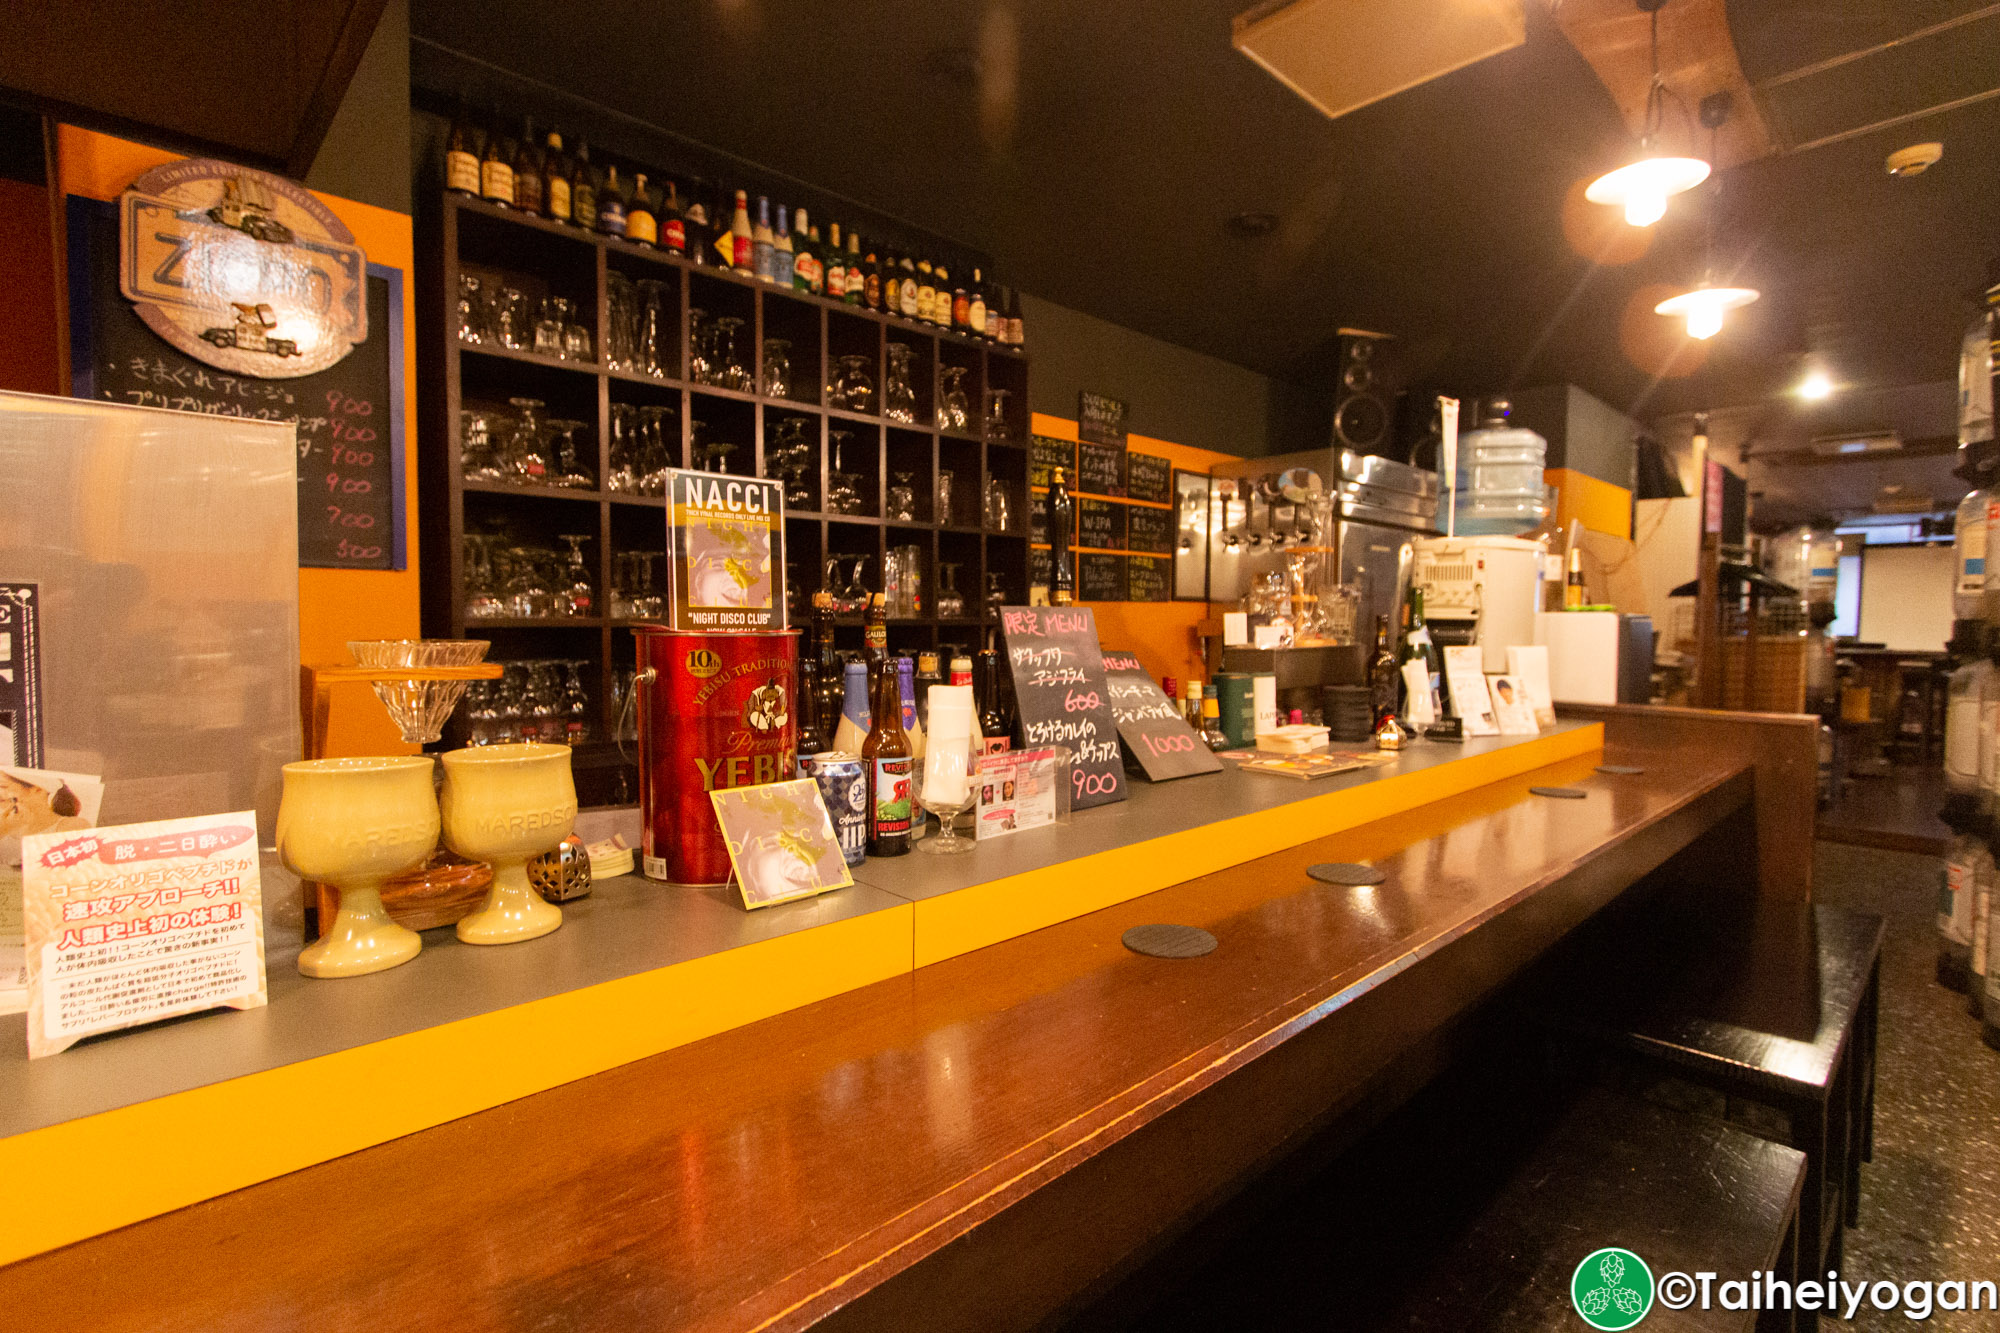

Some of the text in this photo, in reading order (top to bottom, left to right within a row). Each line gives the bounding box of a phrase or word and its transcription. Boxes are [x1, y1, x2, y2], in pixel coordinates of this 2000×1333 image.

[160, 165, 207, 184] LIMITED
[327, 473, 372, 494] 900
[685, 477, 770, 515] NACCI
[327, 506, 375, 529] 700
[720, 612, 746, 625] DISCO
[1004, 610, 1088, 636] 限定 MENU
[1033, 666, 1086, 687] アジフライ
[1104, 656, 1141, 672] MENU
[692, 658, 790, 706] YEBISU TRADITIO
[1064, 689, 1100, 713] 600
[1026, 717, 1097, 744] とろけるカレイの
[1142, 732, 1195, 758] 1000
[1072, 768, 1117, 800] 900
[46, 834, 237, 866] 日本初 脱・二日酔い
[50, 858, 254, 899] コーンオリゴペプチドが
[56, 902, 242, 951] 人類史上初の体験!
